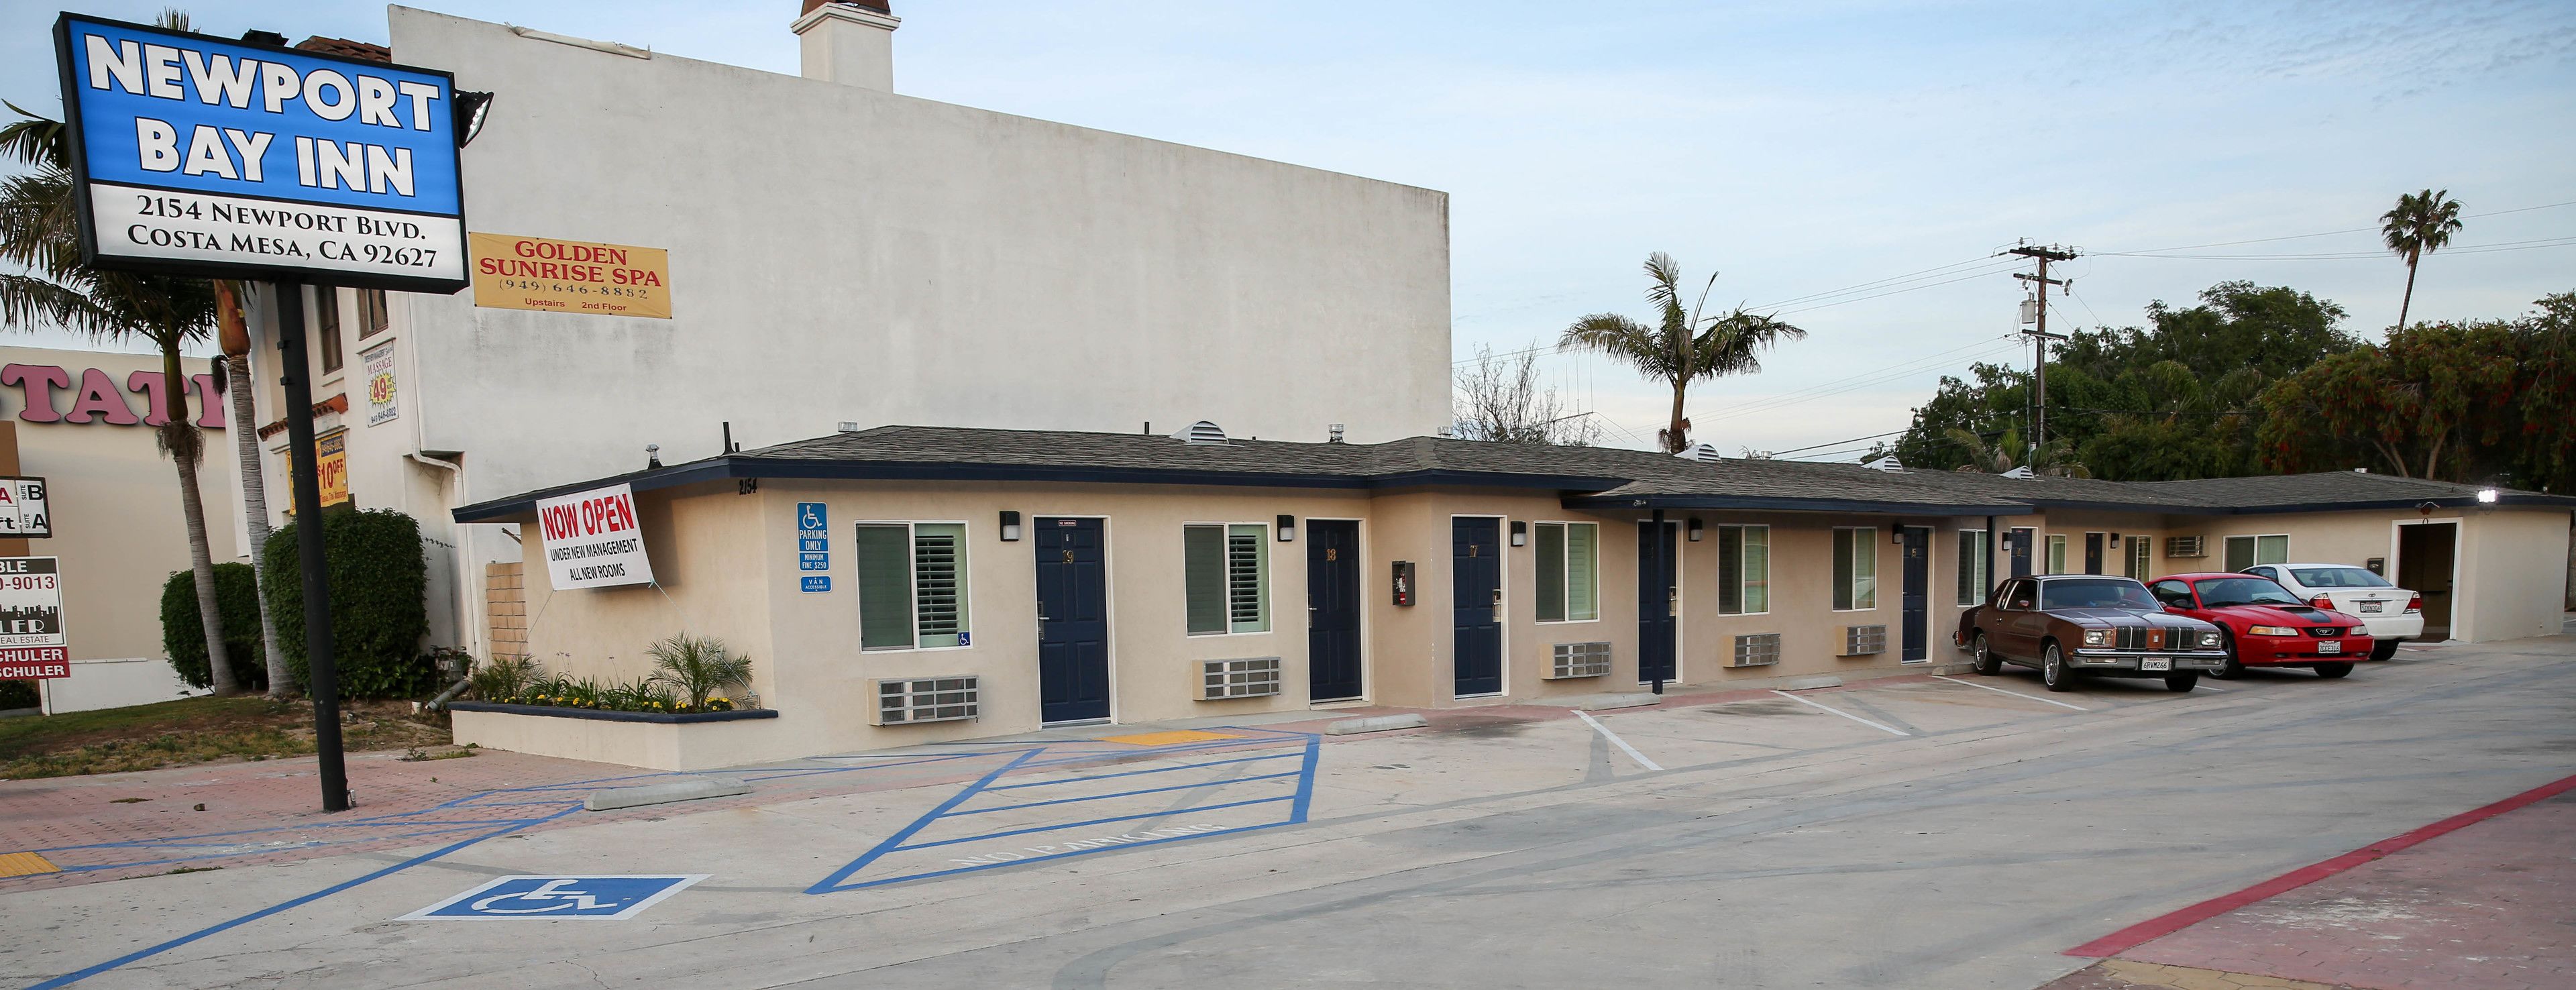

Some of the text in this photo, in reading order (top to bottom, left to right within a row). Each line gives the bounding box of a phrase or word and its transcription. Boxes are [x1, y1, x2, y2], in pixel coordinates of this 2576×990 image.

[85, 33, 440, 132] NEWPORT
[135, 116, 415, 197] BAY INN
[137, 195, 425, 239] 2154 NEWPORT BLVD.
[127, 225, 437, 267] COSTA MESA, CA 92627
[515, 241, 627, 266] GOLDEN
[480, 258, 662, 287] SUNRISE SPA
[499, 278, 649, 299] (949) 646-8882
[525, 298, 627, 312] Upstairs 2nd Floor
[367, 356, 392, 375] MASSAGE
[373, 377, 387, 402] 49
[28, 485, 44, 500] B
[739, 478, 757, 495] 2154
[32, 513, 48, 529] A
[542, 494, 635, 541] NOW OPEN
[799, 530, 827, 539] PARKING
[550, 538, 638, 561] UNDER NEW MANAGEMENT
[805, 541, 822, 551] ONLY
[1326, 549, 1336, 561] 18
[814, 561, 826, 569] $250
[1062, 550, 1074, 564] 19
[570, 563, 625, 581] ALL NEW ROOMS
[20, 635, 49, 643] ESTATE
[2143, 661, 2167, 669] 6RVM266
[948, 824, 1230, 867] NO PARKING
